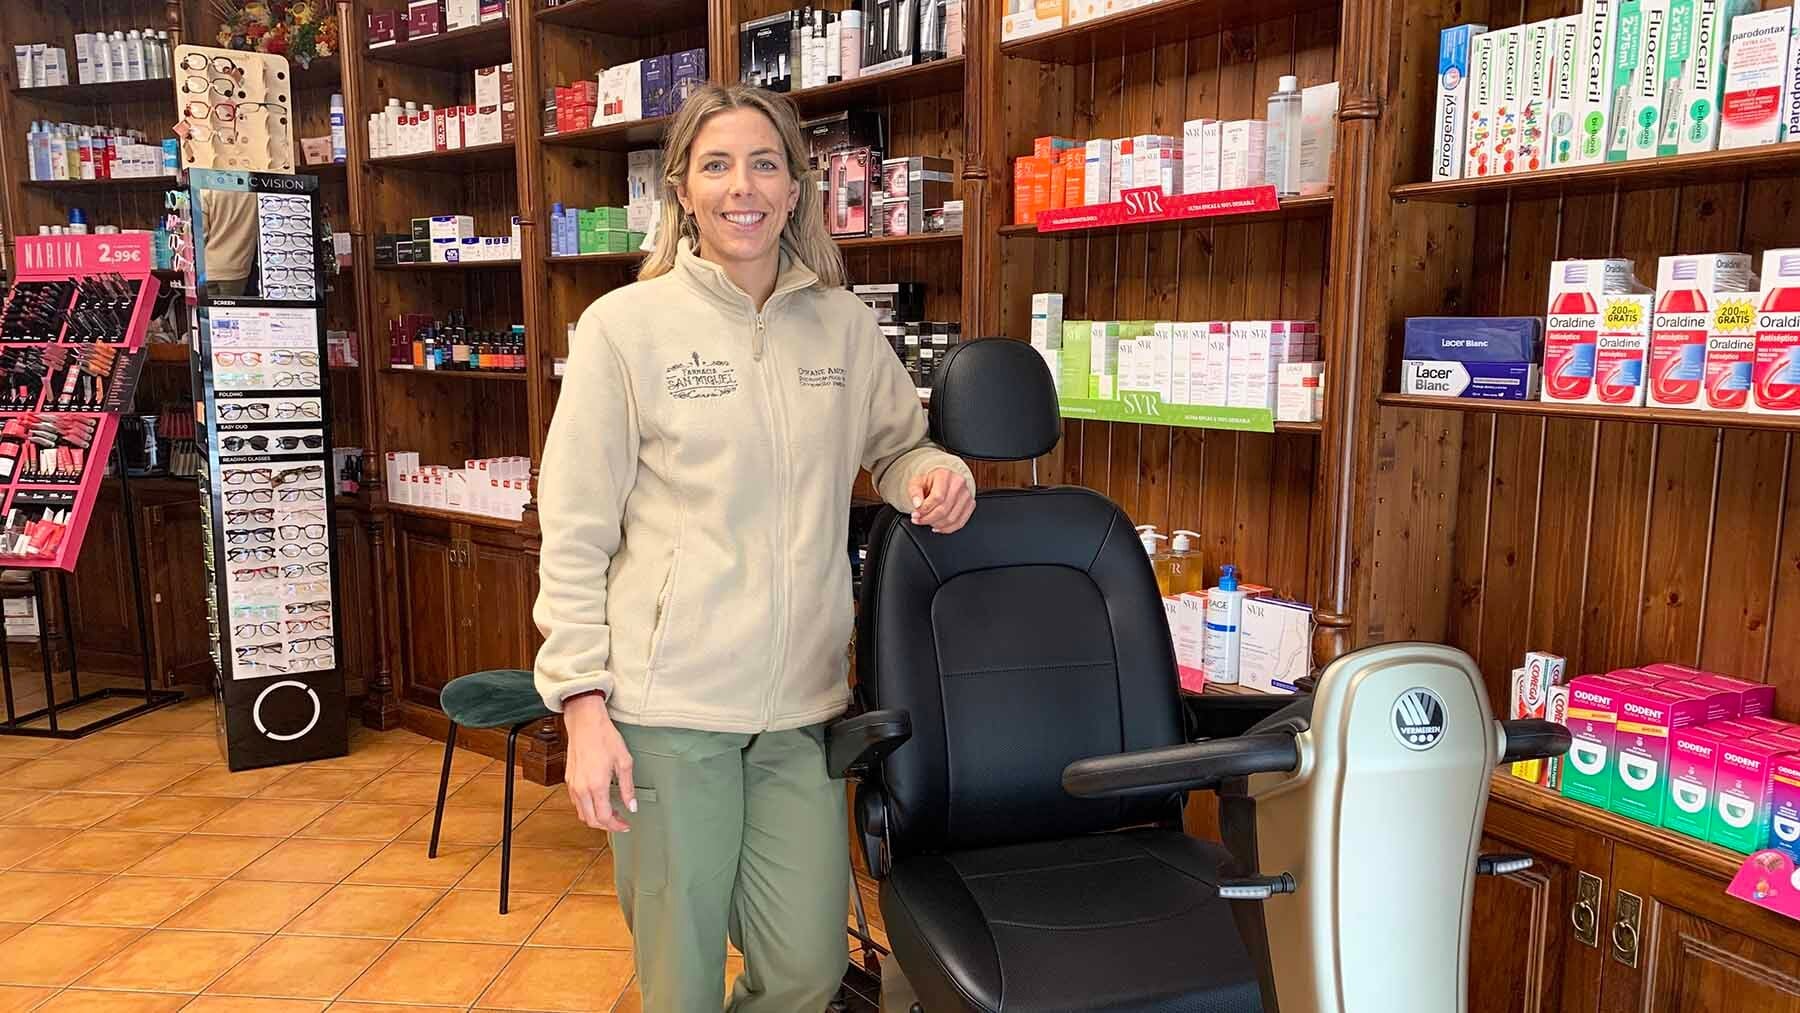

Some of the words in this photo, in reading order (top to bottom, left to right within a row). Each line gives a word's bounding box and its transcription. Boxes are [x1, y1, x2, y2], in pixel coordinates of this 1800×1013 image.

[1731, 24, 1786, 44] parodontax
[1589, 0, 1608, 103] Fluocaril
[1644, 9, 1663, 97] Fluocaril
[1696, 0, 1716, 90] Fluocaril
[1505, 32, 1518, 101] Fluocaril
[1533, 26, 1546, 97] Fluocaril
[1560, 23, 1576, 100] Fluocaril
[1479, 37, 1492, 105] Fluocaril
[1439, 94, 1458, 177] Parogencyl
[261, 178, 304, 191] VISION
[1124, 190, 1164, 216] SVR
[24, 241, 83, 269] NARIKA
[98, 243, 141, 264] 2,99€
[1550, 317, 1596, 328] Oraldine
[1607, 314, 1638, 322] GRATIS
[1656, 316, 1705, 328] Oraldine
[1718, 315, 1750, 324] GRATIS
[1441, 338, 1464, 347] Lacer
[1466, 339, 1488, 347] Blanc
[1599, 338, 1641, 348] Oraldine
[1709, 339, 1754, 350] Oraldine
[1415, 366, 1453, 379] Lacer
[667, 376, 692, 391] SAN
[692, 373, 737, 386] MIGUEL
[1415, 379, 1450, 391] Blanc
[1123, 394, 1160, 417] SVR
[1183, 599, 1198, 611] SVR
[1246, 604, 1265, 617] SVR
[1529, 663, 1541, 701] COREGA
[1574, 690, 1613, 705] ODDENT
[1554, 698, 1565, 724] CORE
[1624, 703, 1664, 719] ODDENT
[1677, 740, 1712, 755] ODDENT
[1724, 752, 1761, 769] ODDENT
